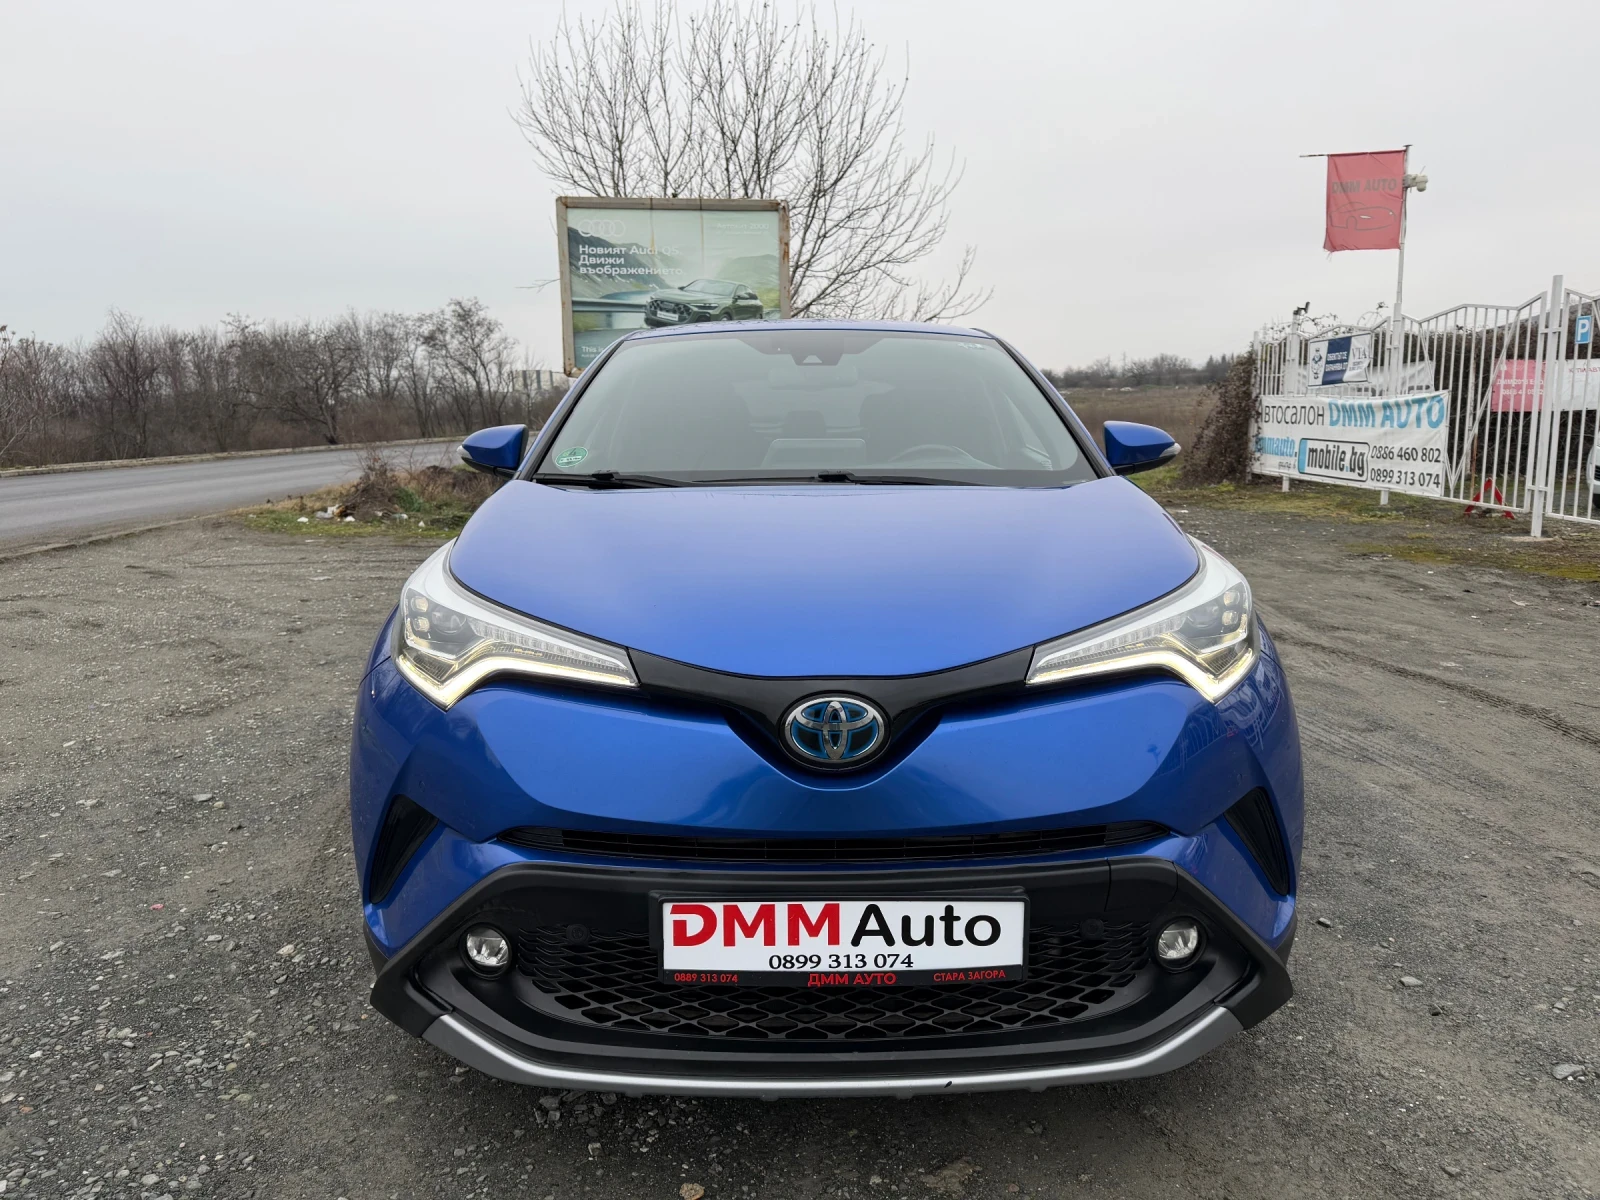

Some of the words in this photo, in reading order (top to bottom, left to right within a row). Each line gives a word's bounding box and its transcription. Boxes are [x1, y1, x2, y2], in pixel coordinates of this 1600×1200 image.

[579, 244, 627, 255] Новият
[629, 245, 658, 255] Audi
[578, 254, 625, 266] Движи
[1577, 319, 1590, 342] P
[1328, 399, 1376, 428] DMM
[1380, 395, 1445, 429] AUTO
[1307, 443, 1366, 477] mobile.bg
[1370, 445, 1395, 460] 0886
[1397, 446, 1419, 461] 460
[1420, 447, 1441, 463] 802
[1370, 467, 1395, 483] 0899
[1395, 470, 1416, 486] 313
[1418, 472, 1441, 488] 074
[670, 903, 840, 946] DMM
[851, 904, 1001, 947] Auto
[768, 954, 822, 969] 0899
[828, 954, 867, 969] 313
[874, 953, 914, 968] 074
[674, 973, 698, 982] 0889
[700, 973, 718, 982] 313
[720, 973, 738, 983] 074
[807, 973, 849, 987] ДММ
[853, 972, 897, 985] АУТО
[933, 972, 965, 982] СТАРА
[968, 969, 1006, 981] ЗАГОРА
